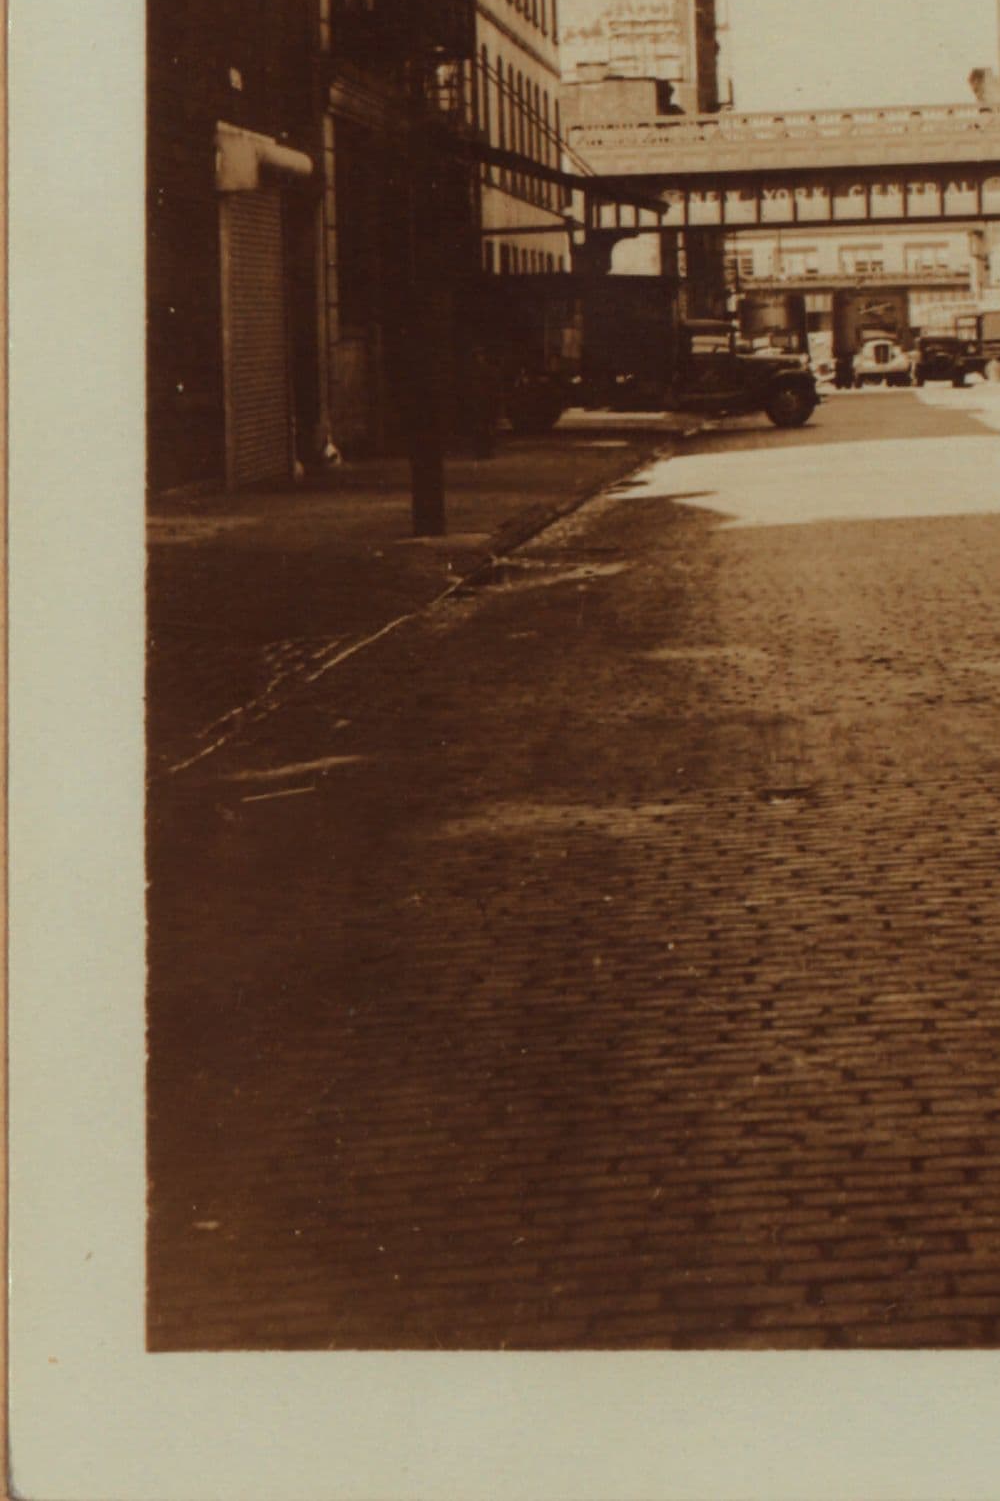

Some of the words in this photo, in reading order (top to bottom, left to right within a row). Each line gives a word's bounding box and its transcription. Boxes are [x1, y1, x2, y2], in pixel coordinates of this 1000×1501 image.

[689, 190, 741, 205] NEW
[762, 186, 825, 203] YORK
[848, 181, 970, 198] CENTRAL
